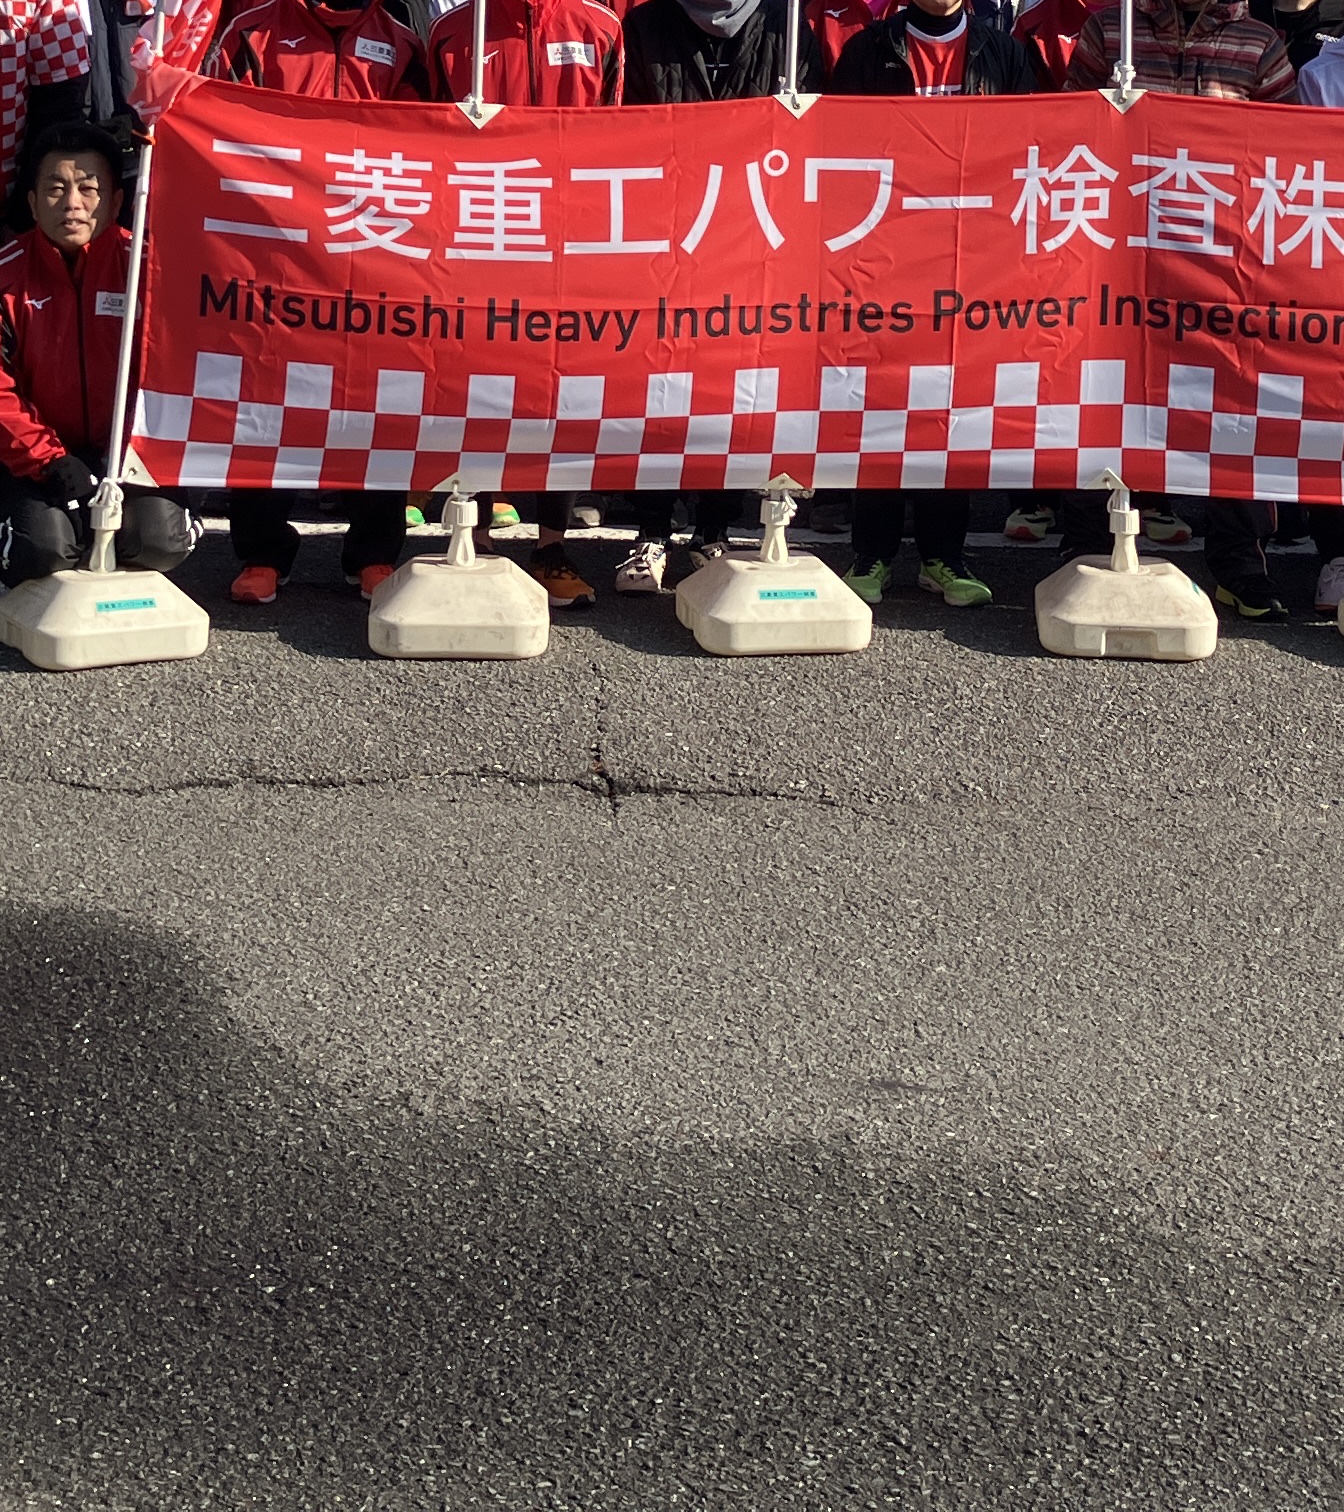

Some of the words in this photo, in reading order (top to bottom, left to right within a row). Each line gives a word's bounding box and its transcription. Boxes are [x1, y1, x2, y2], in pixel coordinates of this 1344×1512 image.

[198, 273, 465, 341] Mitsubishi
[486, 297, 641, 351] Heavy
[657, 289, 916, 341] Industries
[932, 289, 1080, 334] Power
